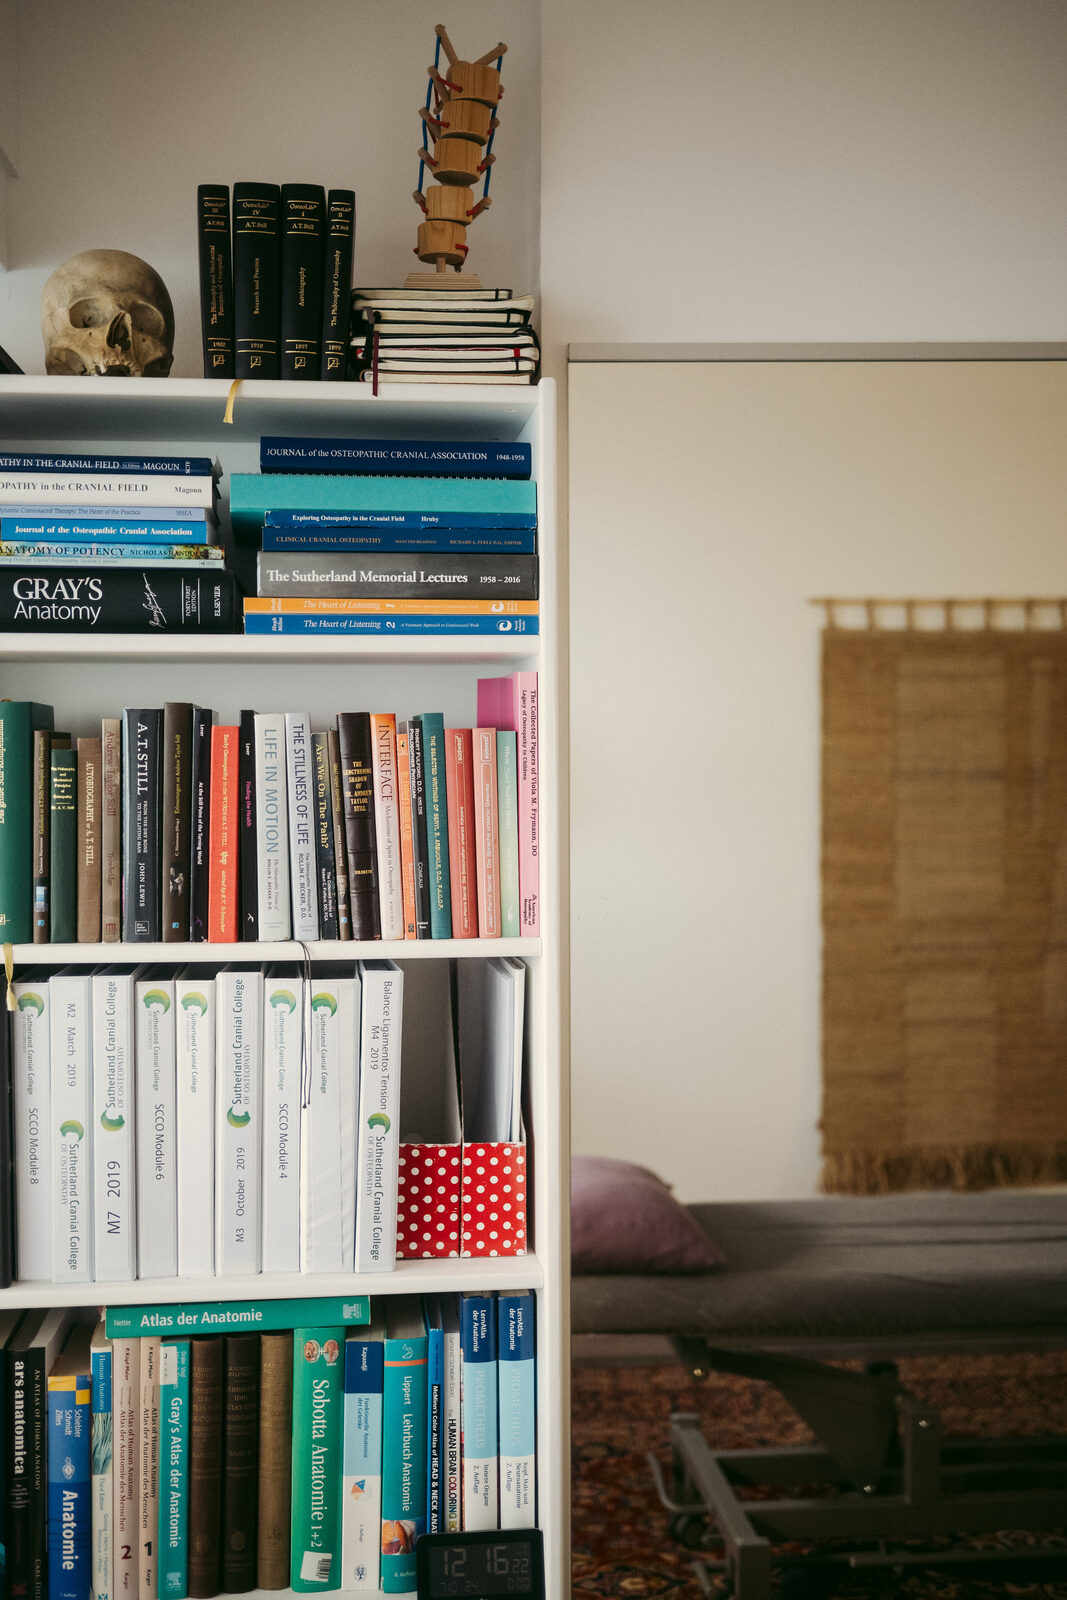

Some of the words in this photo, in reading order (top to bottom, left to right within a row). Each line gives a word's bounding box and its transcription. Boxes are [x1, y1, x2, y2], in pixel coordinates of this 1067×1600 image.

[143, 462, 179, 470] MAGOUN
[266, 448, 307, 457] JOURNAL
[330, 450, 388, 458] OSTEOPATHIC
[431, 452, 487, 460] ASSOCIATION
[174, 486, 202, 494] Magoun
[15, 525, 44, 533] Journal
[73, 526, 117, 536] Osteopathic
[119, 527, 148, 535] Cranial
[150, 527, 193, 536] Association
[13, 577, 103, 600] GRAY'S
[266, 570, 290, 582] The
[292, 570, 357, 583] Sutherland
[359, 571, 416, 583] Memorial
[419, 571, 468, 583] Lectures
[14, 601, 101, 625] Anatomy
[304, 620, 318, 628] The
[319, 620, 338, 628] Heart
[340, 620, 348, 629] of
[348, 620, 381, 630] Listening
[264, 729, 278, 759] LIFE
[292, 724, 305, 745] THE
[106, 730, 116, 767] Andrew
[315, 744, 325, 763] Are
[264, 766, 278, 782] IN
[294, 749, 307, 801] STILLNESS
[317, 765, 326, 781] We
[378, 724, 393, 802] INTERFACE
[104, 769, 116, 796] Taylor
[318, 783, 326, 798] On
[106, 798, 117, 816] Still
[296, 805, 308, 818] OF
[318, 800, 327, 819] The
[531, 797, 537, 806] M.
[265, 789, 279, 853] MOTION
[296, 823, 309, 845] LIFE
[319, 821, 329, 848] Path?
[532, 845, 537, 856] DO
[106, 982, 117, 1016] College
[233, 979, 244, 1013] College
[382, 981, 391, 1016] Balance
[67, 1004, 76, 1018] M2
[67, 1027, 76, 1056] March
[105, 1019, 116, 1052] Cranial
[232, 1016, 243, 1049] Cranial
[371, 1025, 379, 1040] M4
[381, 1018, 392, 1071] Ligamentos
[371, 1048, 379, 1070] 2019
[67, 1064, 76, 1086] 2019
[105, 1055, 116, 1108] Sutherland
[231, 1051, 242, 1105] Sutherland
[380, 1074, 389, 1110] Tension
[70, 1144, 79, 1197] Sutherland
[236, 1147, 245, 1170] 2019
[374, 1136, 385, 1190] Sutherland
[107, 1161, 121, 1198] 2019
[236, 1179, 245, 1216] October
[373, 1192, 384, 1224] Cranial
[69, 1200, 79, 1233] Cranial
[107, 1212, 121, 1234] M7
[236, 1228, 245, 1242] M3
[371, 1227, 383, 1260] College
[69, 1236, 80, 1270] College
[140, 1313, 173, 1327] Atlas
[177, 1312, 198, 1325] der
[201, 1309, 263, 1324] Anatomie
[14, 1361, 26, 1387] ars
[98, 1381, 106, 1410] Anatomy
[402, 1376, 413, 1405] Lippert
[65, 1409, 73, 1435] Schmidt
[312, 1379, 329, 1440] Sobotta
[14, 1390, 27, 1475] anatomica
[402, 1413, 413, 1460] Lehrbuch
[170, 1436, 182, 1468] Atlas
[170, 1469, 182, 1489] der
[311, 1444, 328, 1521] Anatomie
[402, 1463, 412, 1511] Anatomie
[62, 1490, 79, 1570] Anatomie
[169, 1491, 181, 1548] Anatomie
[145, 1542, 152, 1556] 1
[310, 1525, 323, 1548] 1+2
[121, 1545, 132, 1560] 2
